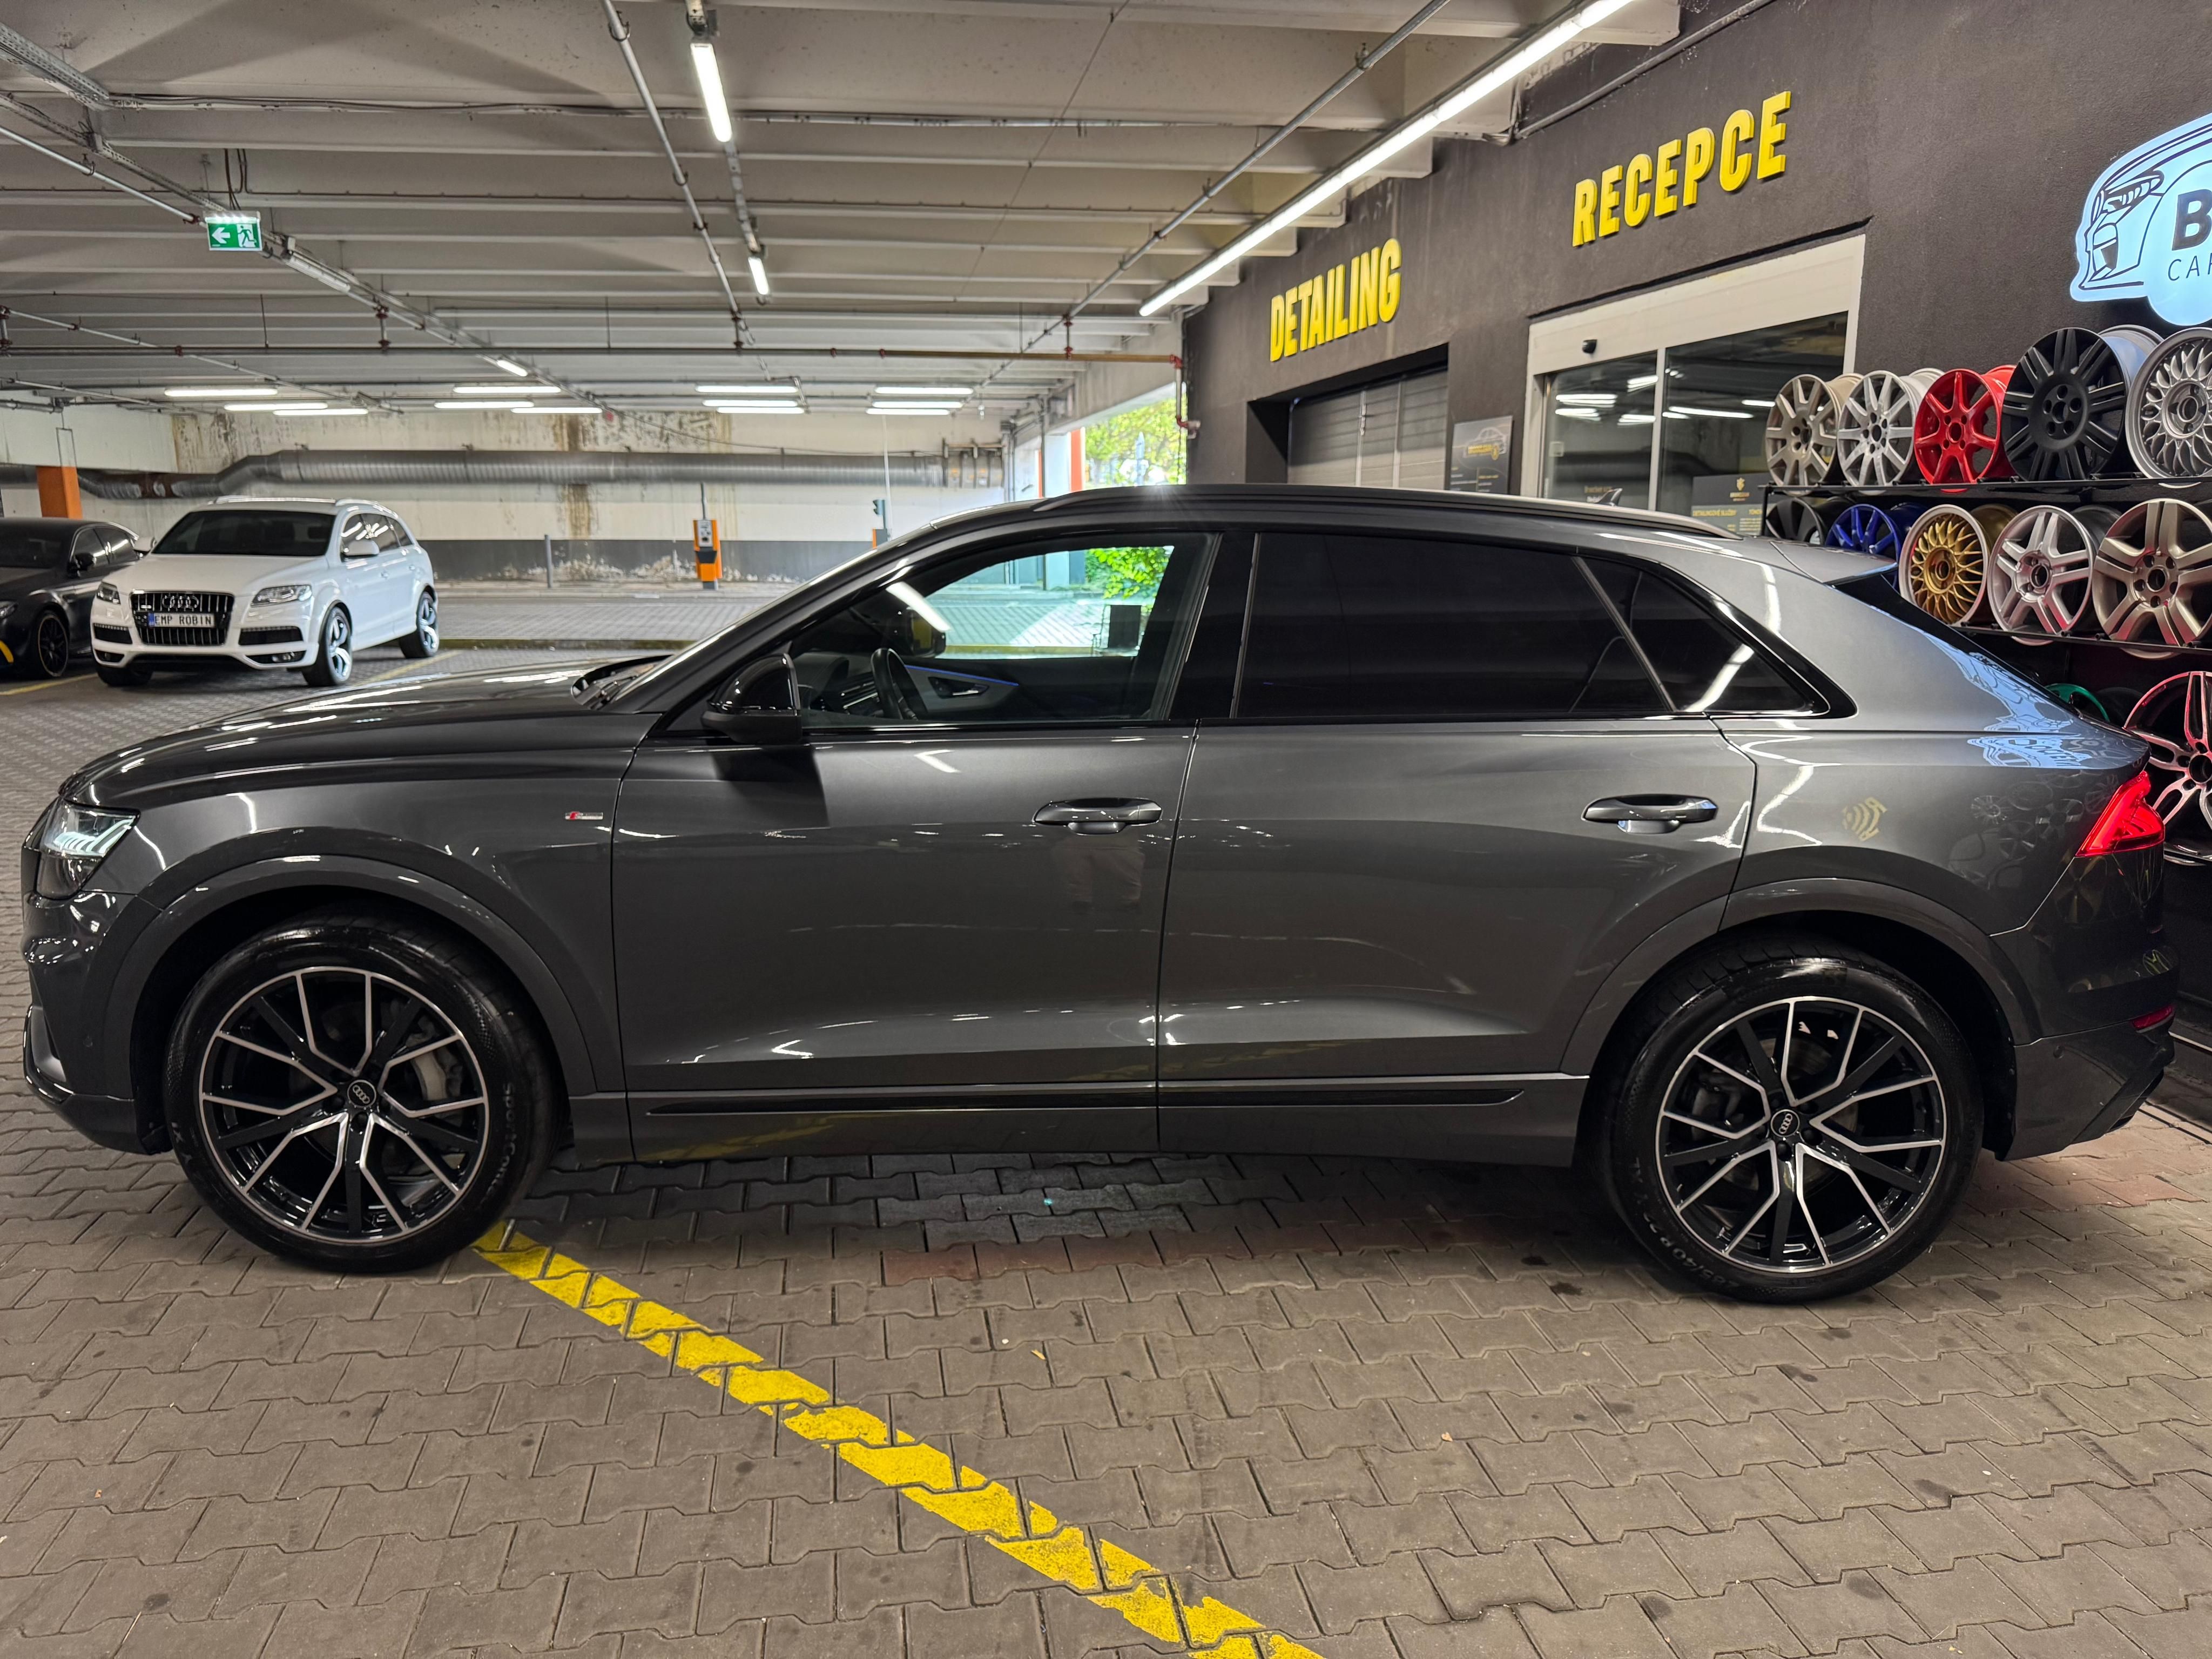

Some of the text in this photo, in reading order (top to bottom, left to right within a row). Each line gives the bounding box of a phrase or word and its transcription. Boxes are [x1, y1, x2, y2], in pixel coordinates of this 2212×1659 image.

[1572, 91, 1791, 247] RECEPCE
[1270, 238, 1402, 362] DETAILING
[179, 614, 212, 626] ROBIN
